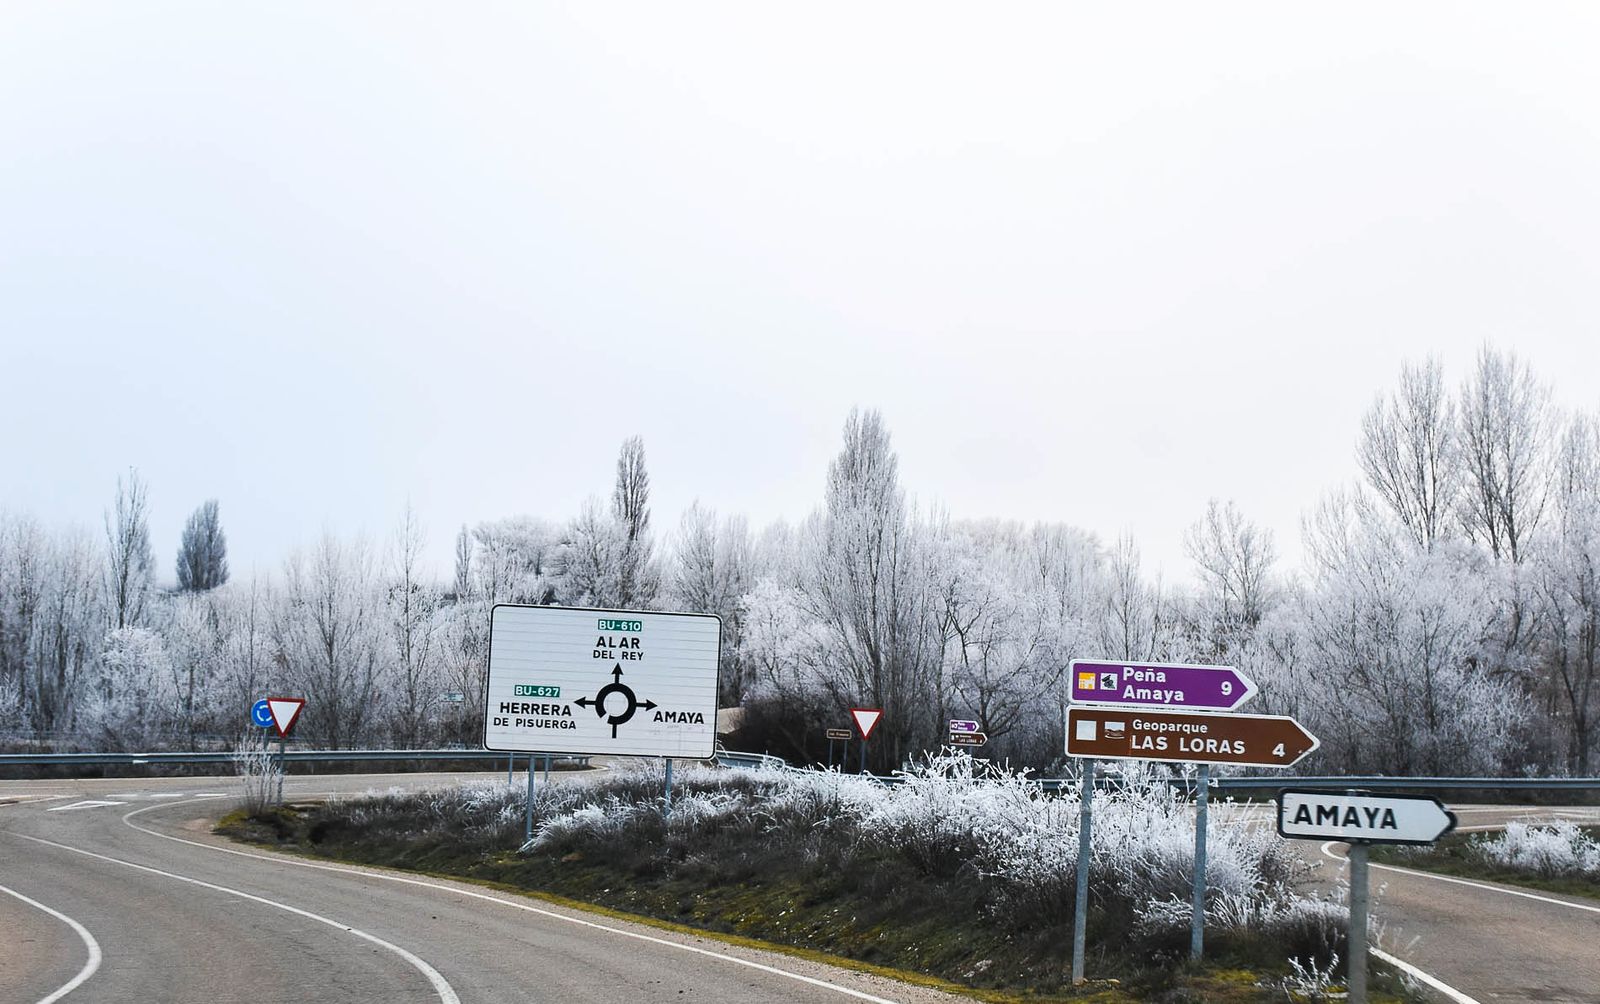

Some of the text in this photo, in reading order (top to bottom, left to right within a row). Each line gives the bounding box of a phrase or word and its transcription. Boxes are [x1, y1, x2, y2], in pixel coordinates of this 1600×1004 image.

[599, 620, 641, 632] BU-610
[596, 636, 640, 648] ALAR
[593, 650, 644, 660] DEL REY
[1123, 667, 1166, 682] Peña
[515, 686, 560, 697] BU-627
[1123, 685, 1184, 704] Amaya
[1220, 681, 1233, 696] 9
[500, 702, 572, 716] HERRERA
[494, 718, 576, 730] DE PISUERGA
[654, 711, 704, 724] AMAYA
[1132, 720, 1208, 734] Geoparque
[1131, 734, 1286, 757] LAS LORAS 4
[1294, 804, 1398, 830] AMAYA
